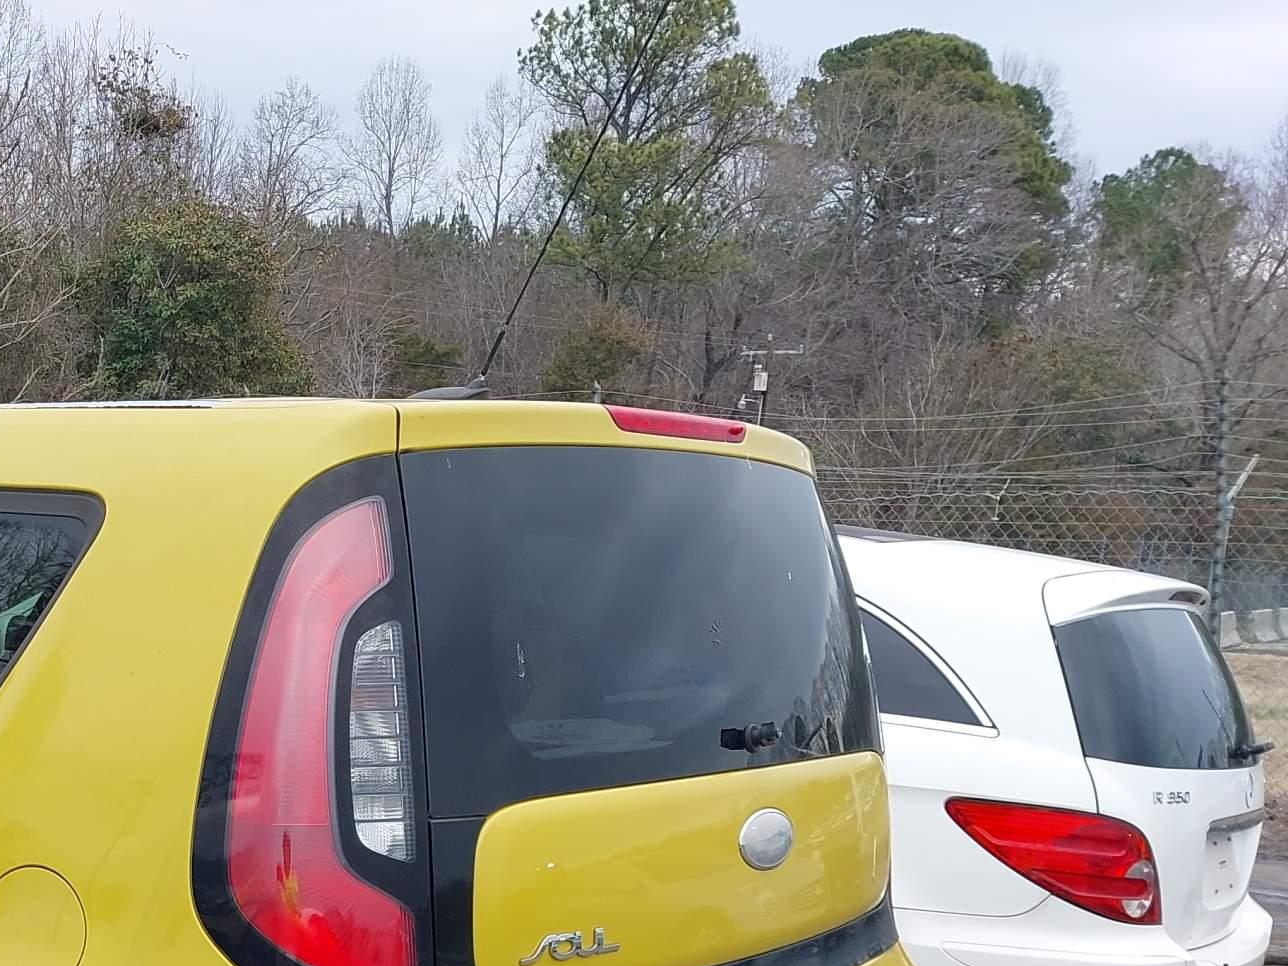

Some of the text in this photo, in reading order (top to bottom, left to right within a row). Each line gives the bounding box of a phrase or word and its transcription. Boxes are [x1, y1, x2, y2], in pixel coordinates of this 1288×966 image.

[1152, 791, 1191, 804] R 350
[518, 927, 622, 966] SOUL
